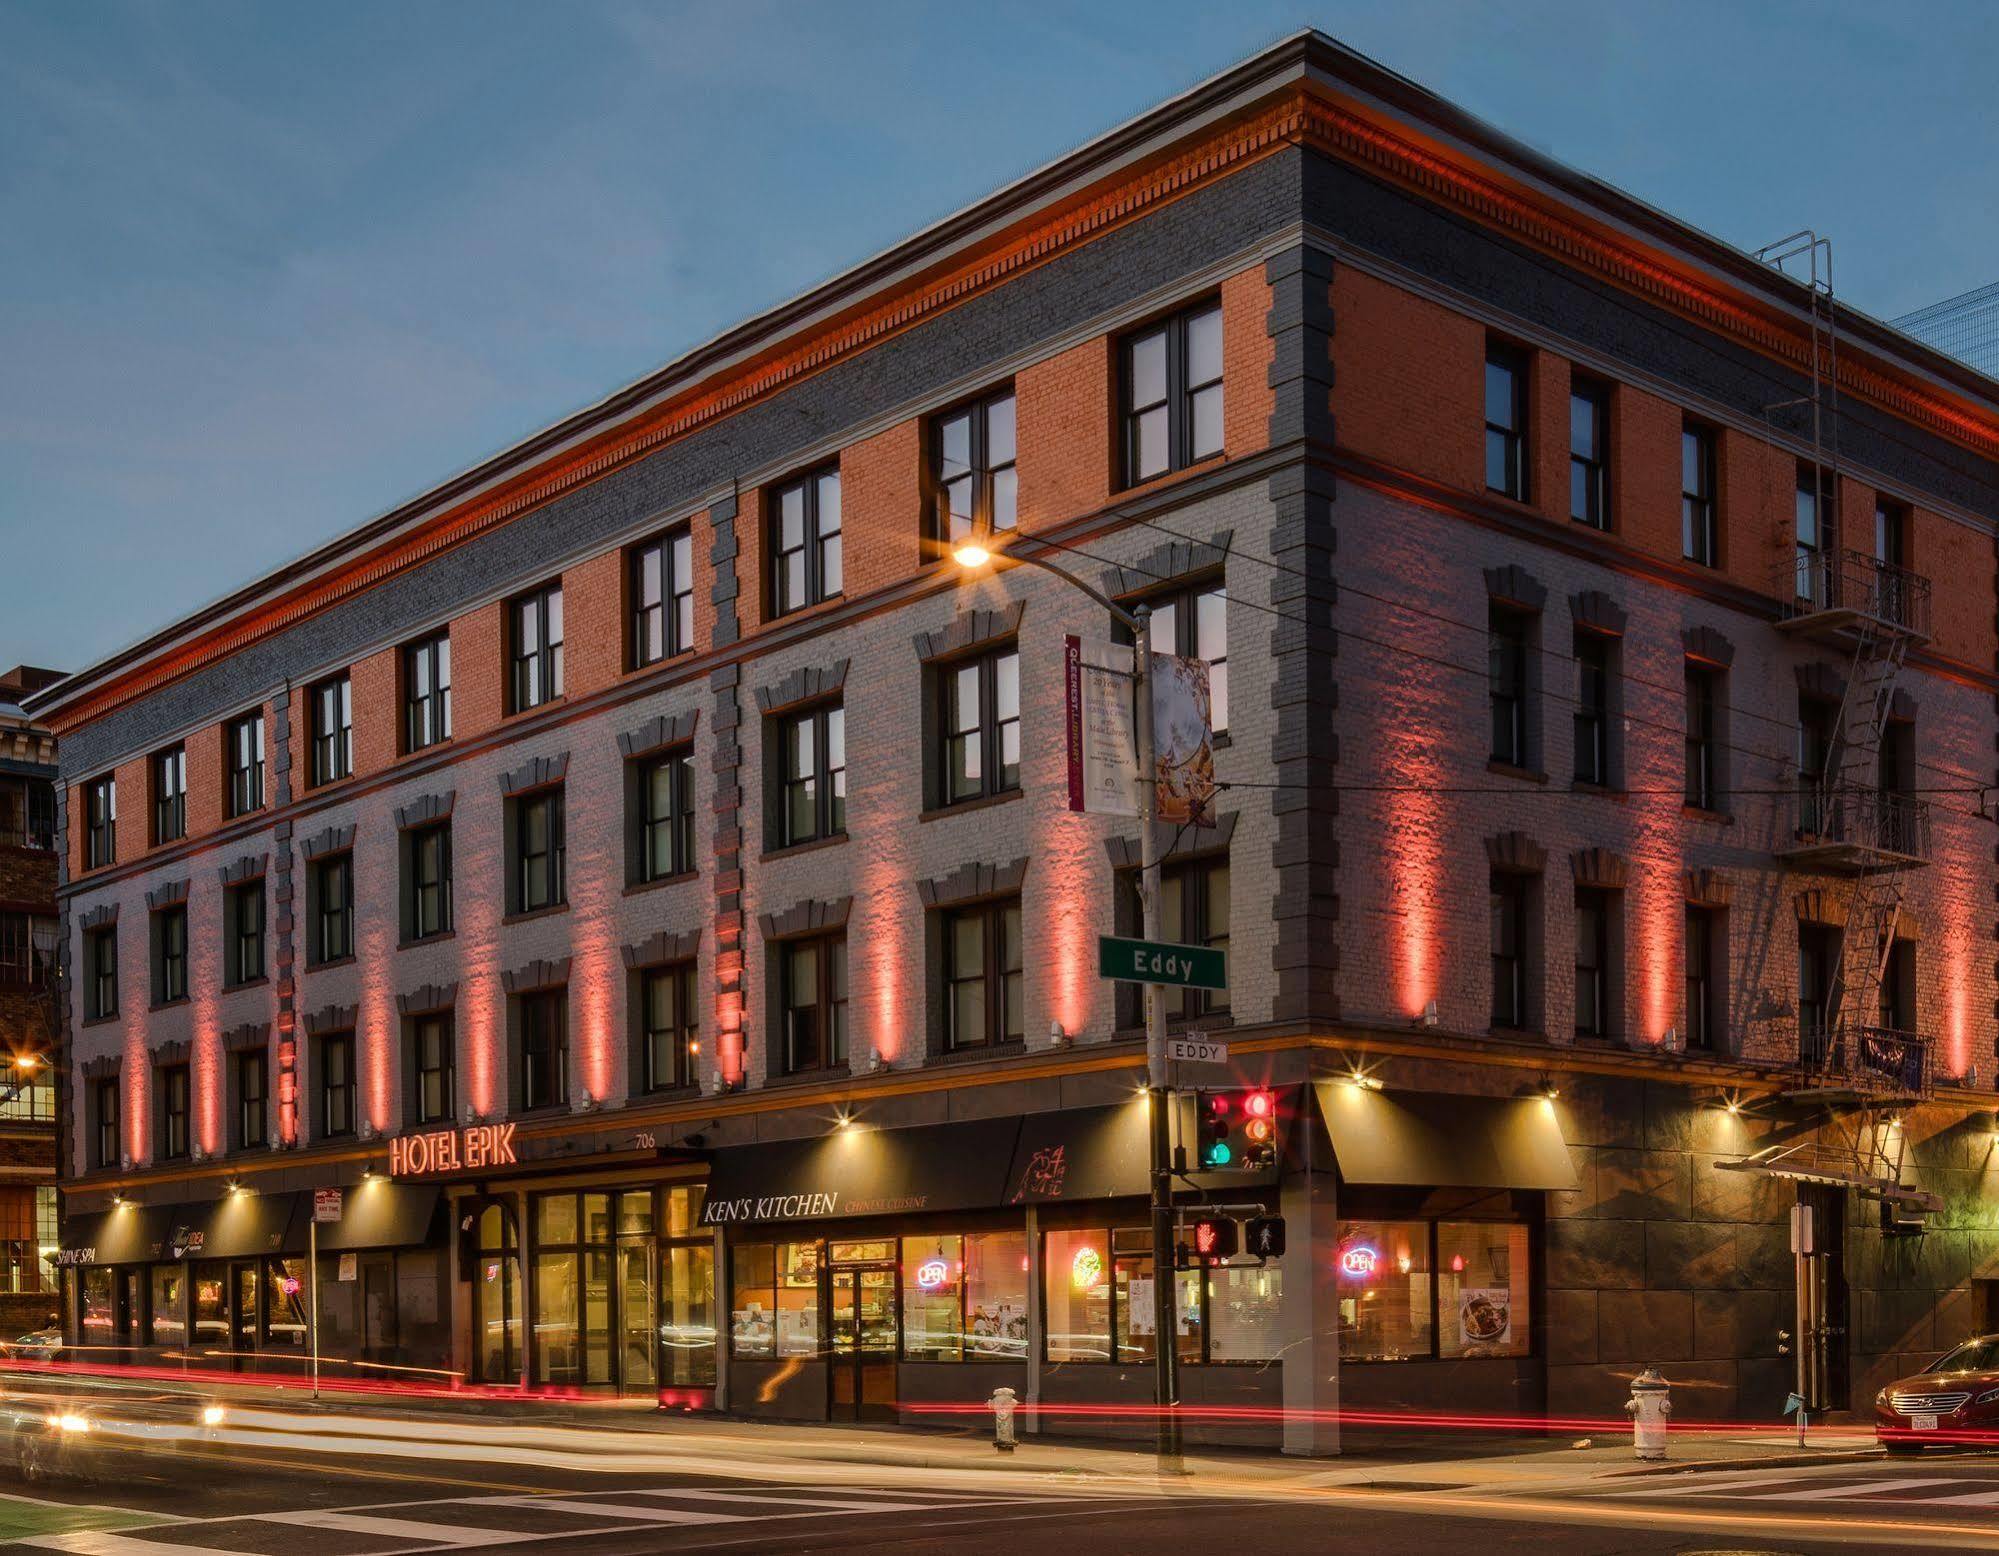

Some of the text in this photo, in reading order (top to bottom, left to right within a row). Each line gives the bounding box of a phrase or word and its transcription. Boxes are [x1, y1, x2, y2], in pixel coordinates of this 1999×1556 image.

[1134, 950, 1193, 982] Eddy
[1176, 1044, 1218, 1060] EDDY
[390, 1122, 517, 1176] HOTEL EPIK
[635, 1131, 656, 1150] 706
[704, 1191, 838, 1222] KEN'S KITCHEN
[55, 1247, 96, 1265] SHINE SPA
[1343, 1252, 1375, 1271] OPEN
[918, 1265, 947, 1282] OPEN
